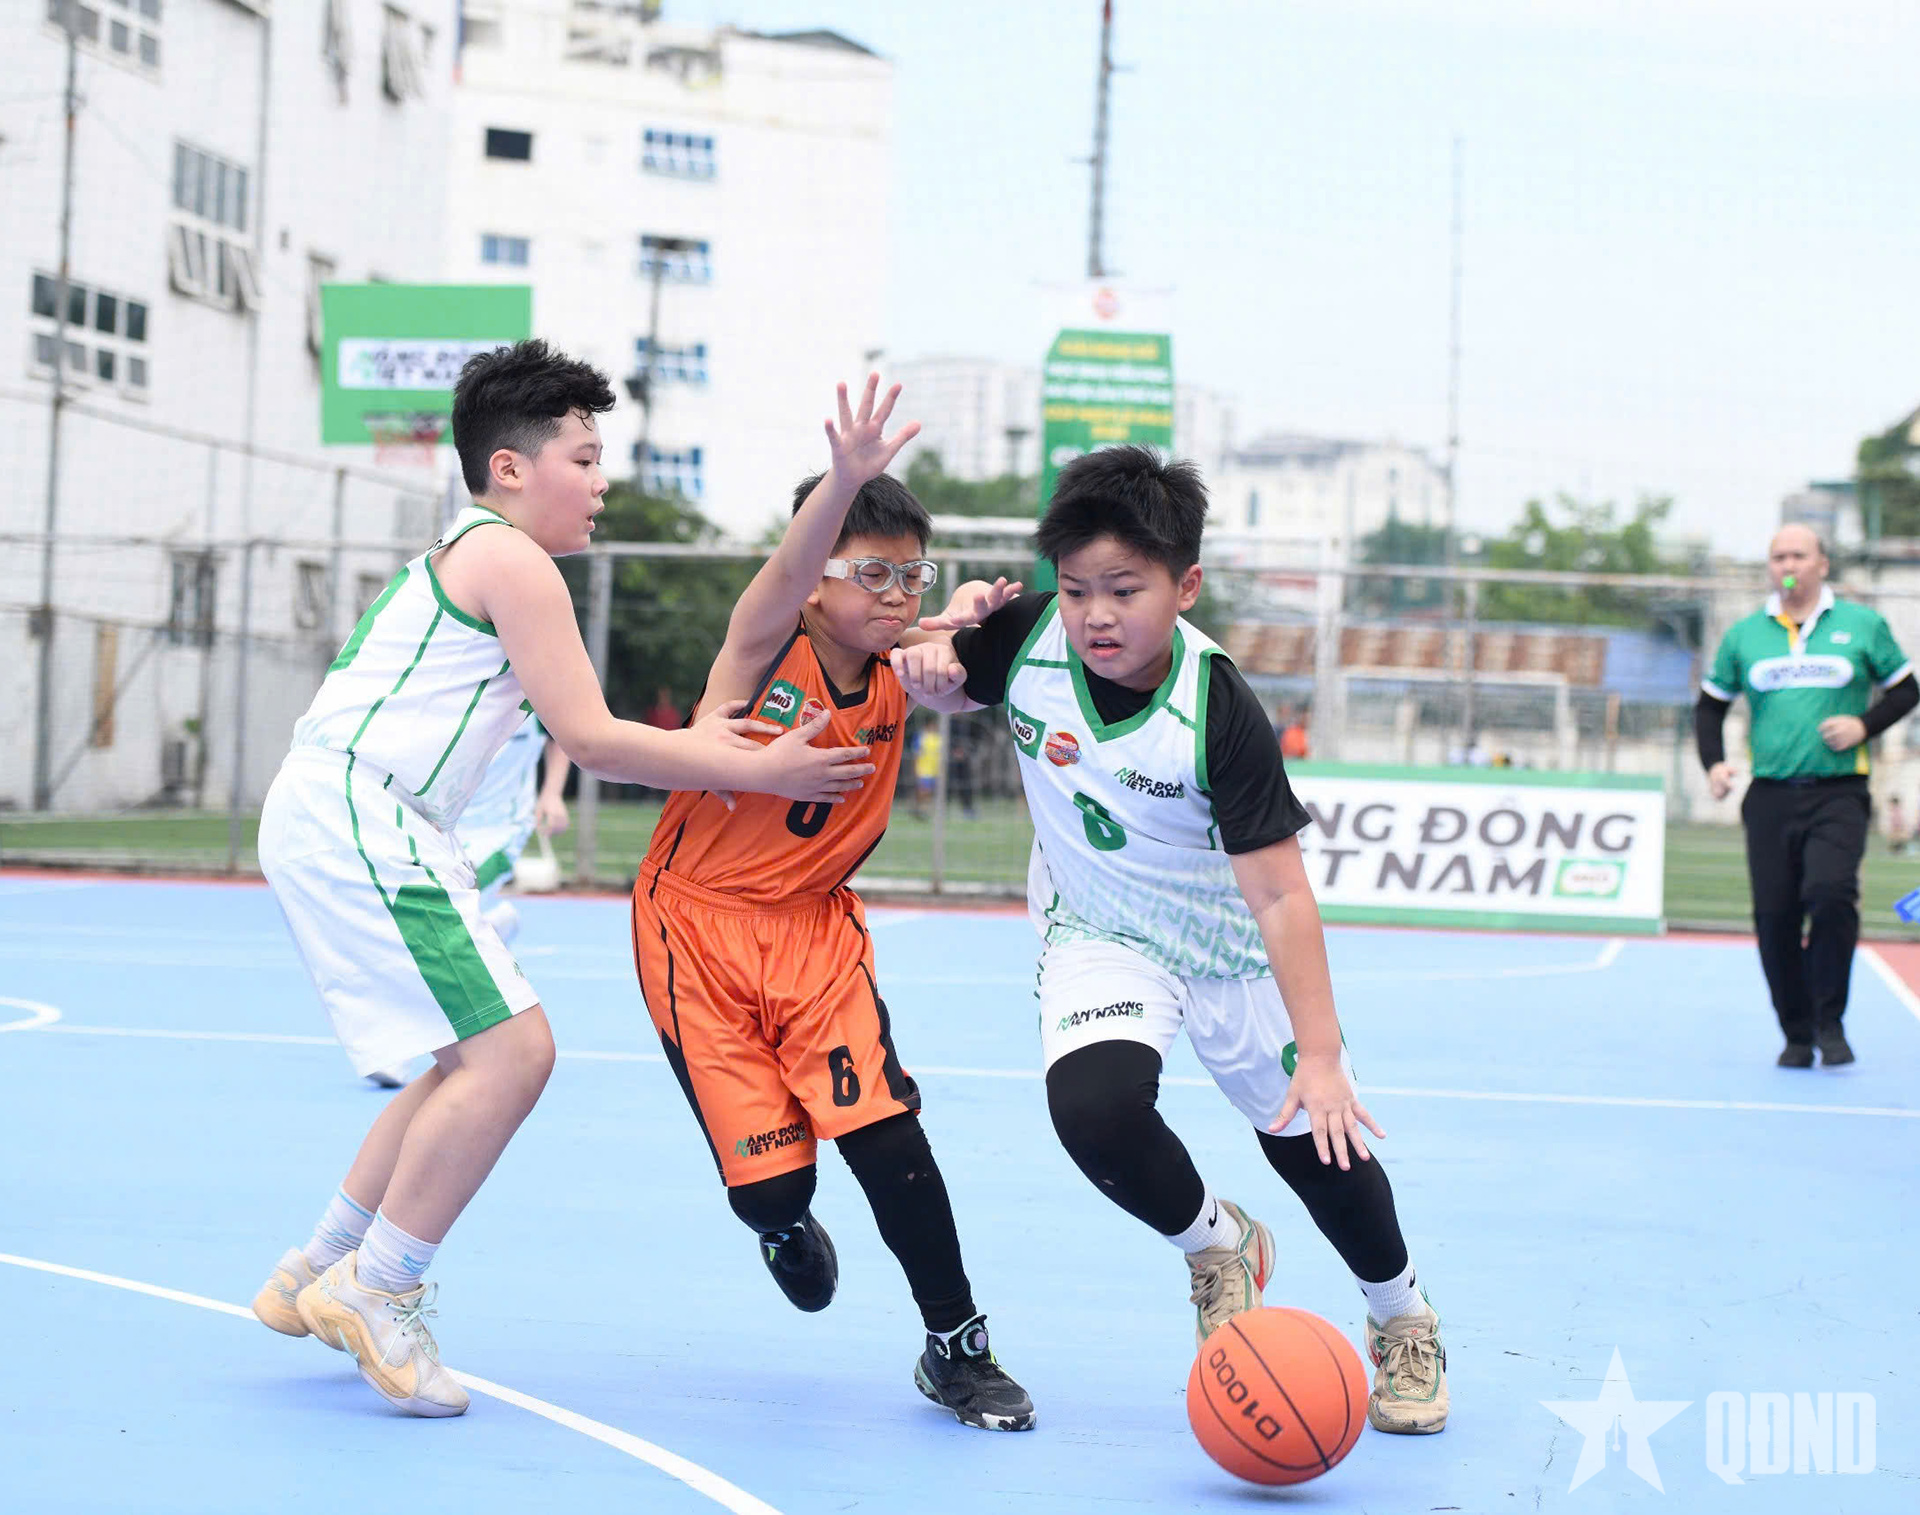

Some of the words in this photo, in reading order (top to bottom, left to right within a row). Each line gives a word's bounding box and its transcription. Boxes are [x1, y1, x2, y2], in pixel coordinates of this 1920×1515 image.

[1146, 787, 1177, 798] NAM
[1300, 802, 1396, 842] NG
[1376, 852, 1546, 895] NAM
[828, 1045, 861, 1107] 6
[734, 1131, 776, 1155] NĂNG
[775, 1133, 800, 1149] NAM
[1209, 1348, 1282, 1441] D1000
